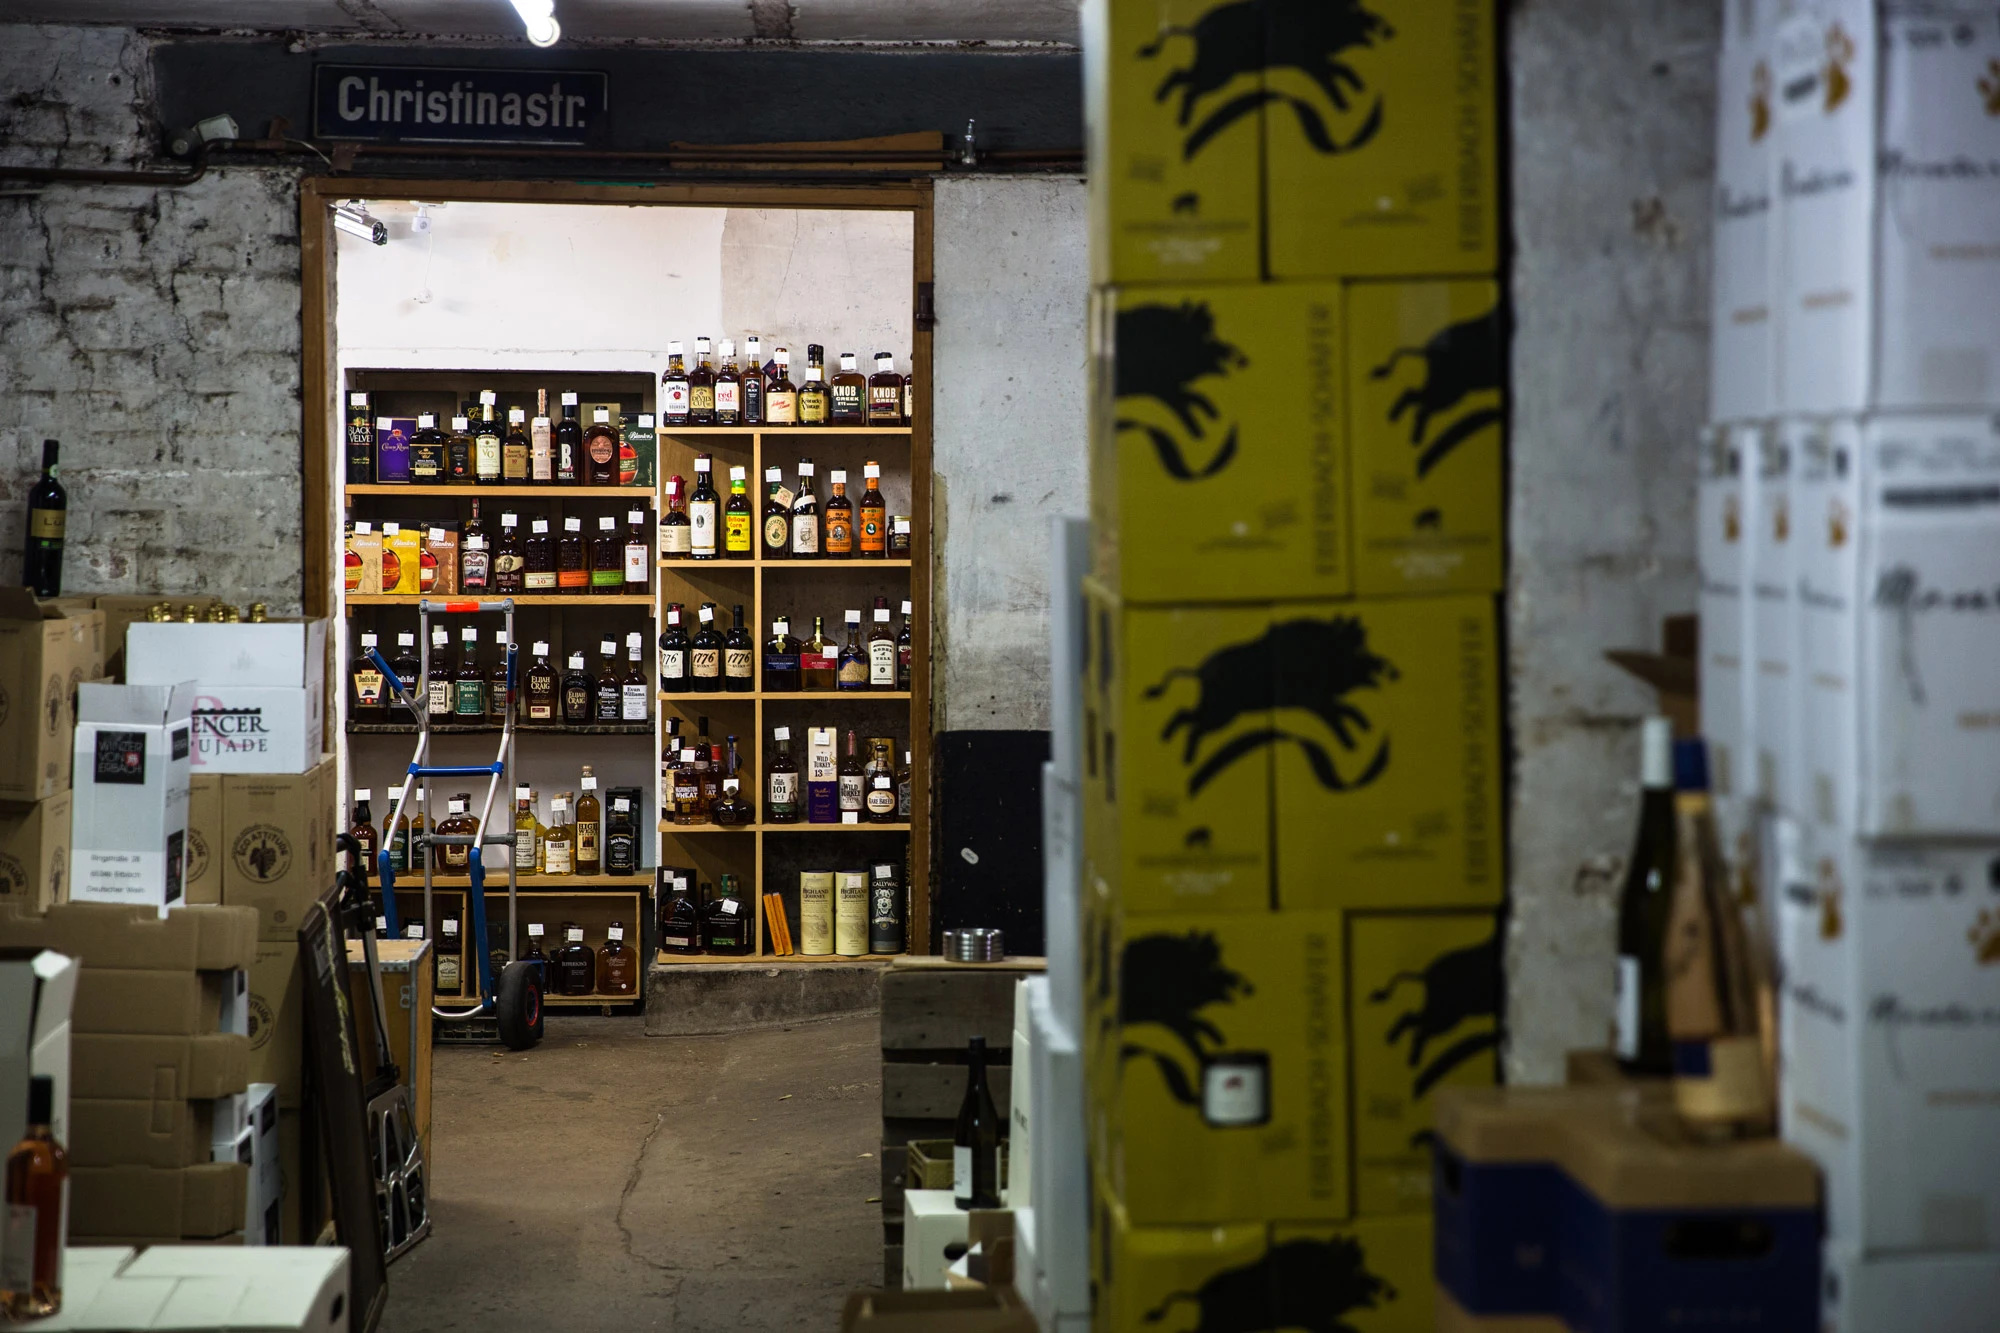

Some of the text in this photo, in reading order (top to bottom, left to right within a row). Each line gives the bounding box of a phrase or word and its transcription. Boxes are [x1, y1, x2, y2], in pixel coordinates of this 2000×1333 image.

[338, 75, 586, 128] Christinastr.
[833, 385, 856, 397] KNOB
[873, 387, 896, 398] KNOB
[348, 426, 371, 435] BLACK
[349, 434, 374, 443] VELVET
[693, 652, 716, 665] 1776
[727, 652, 752, 665] 1776
[531, 675, 550, 683] ELIJAH
[530, 682, 550, 691] CRAIG
[813, 761, 831, 769] TURKEY
[814, 769, 823, 778] 13
[772, 785, 787, 794] 101
[842, 783, 858, 791] WILD
